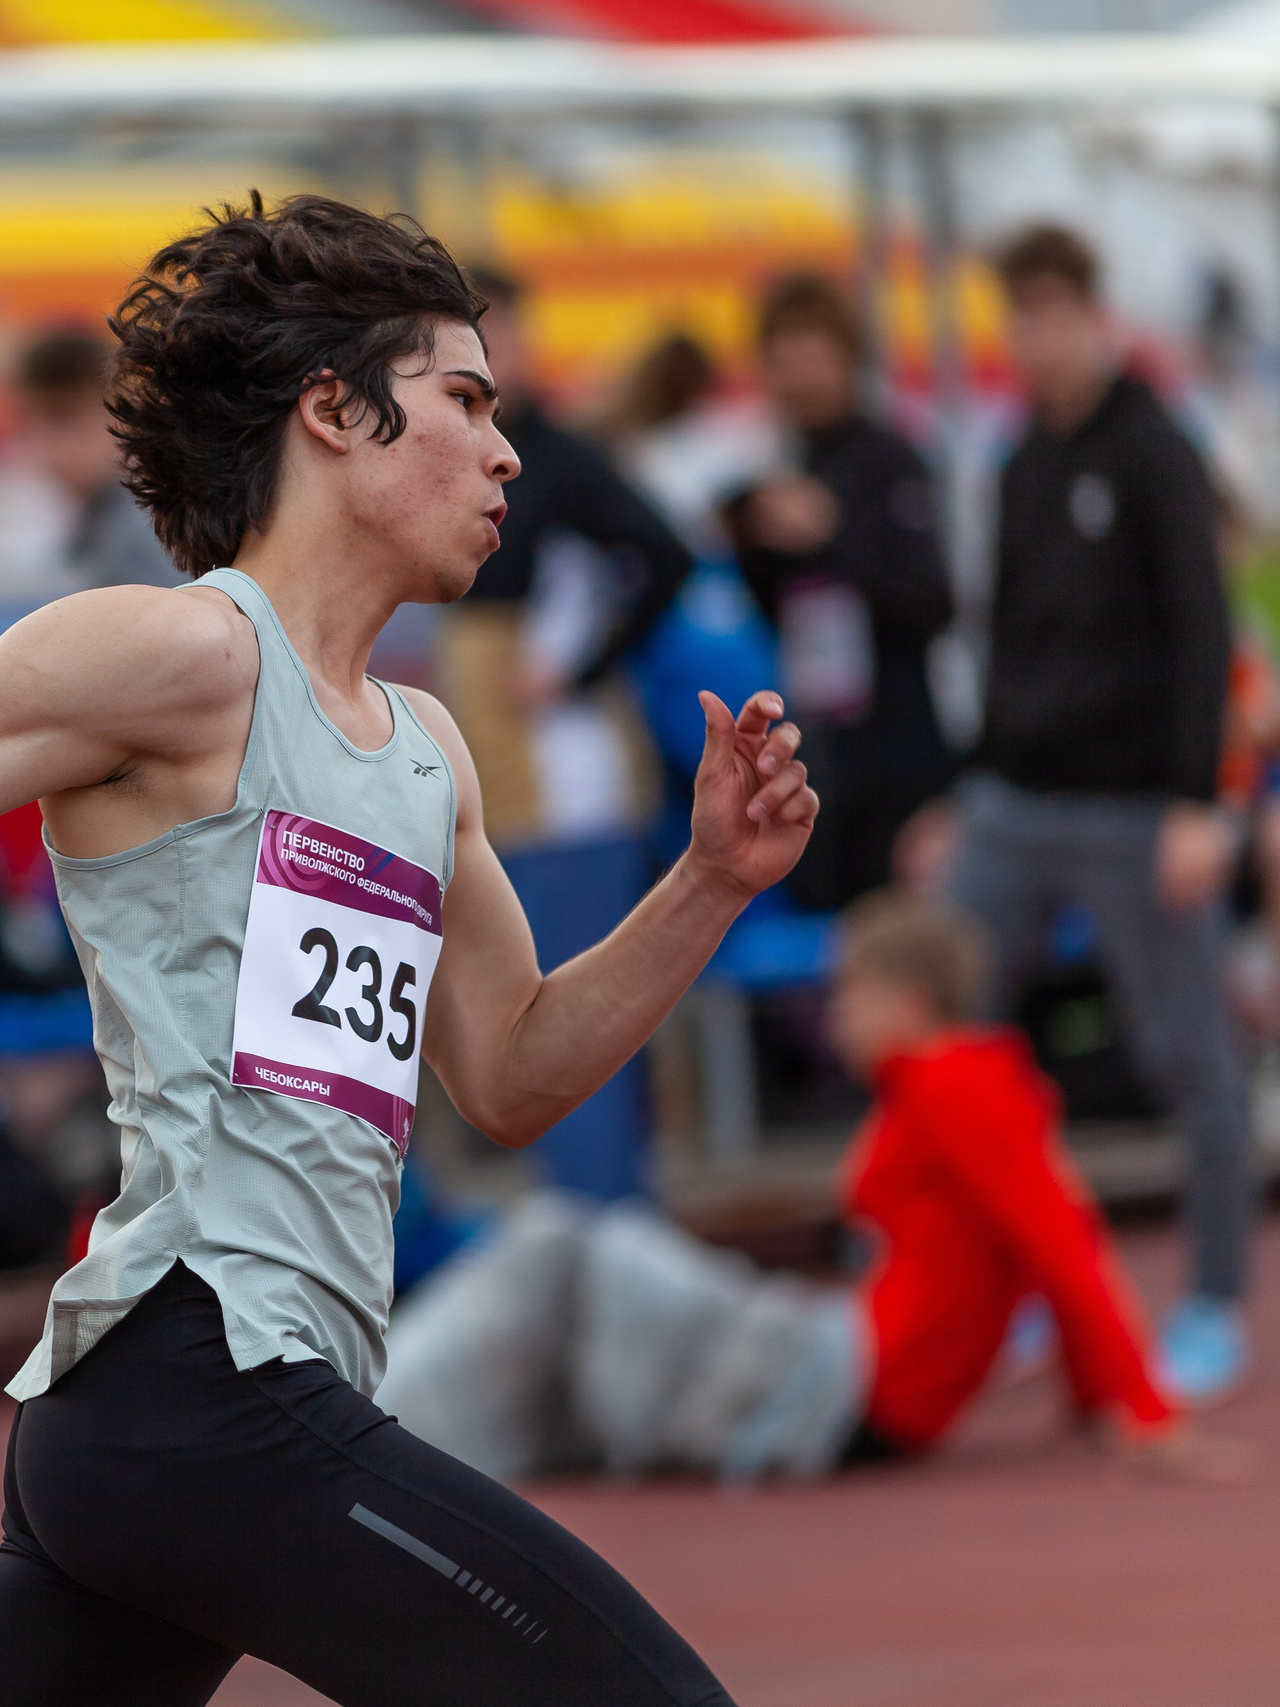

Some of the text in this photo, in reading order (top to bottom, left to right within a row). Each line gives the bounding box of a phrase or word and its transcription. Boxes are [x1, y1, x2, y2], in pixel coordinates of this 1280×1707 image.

[280, 848, 356, 885] ПРИВОЛЖСКОГО
[282, 830, 365, 872] ПЕРВЕНСТВО
[291, 927, 416, 1061] 235
[255, 1066, 330, 1096] ЧЕБОКСАРЫ
